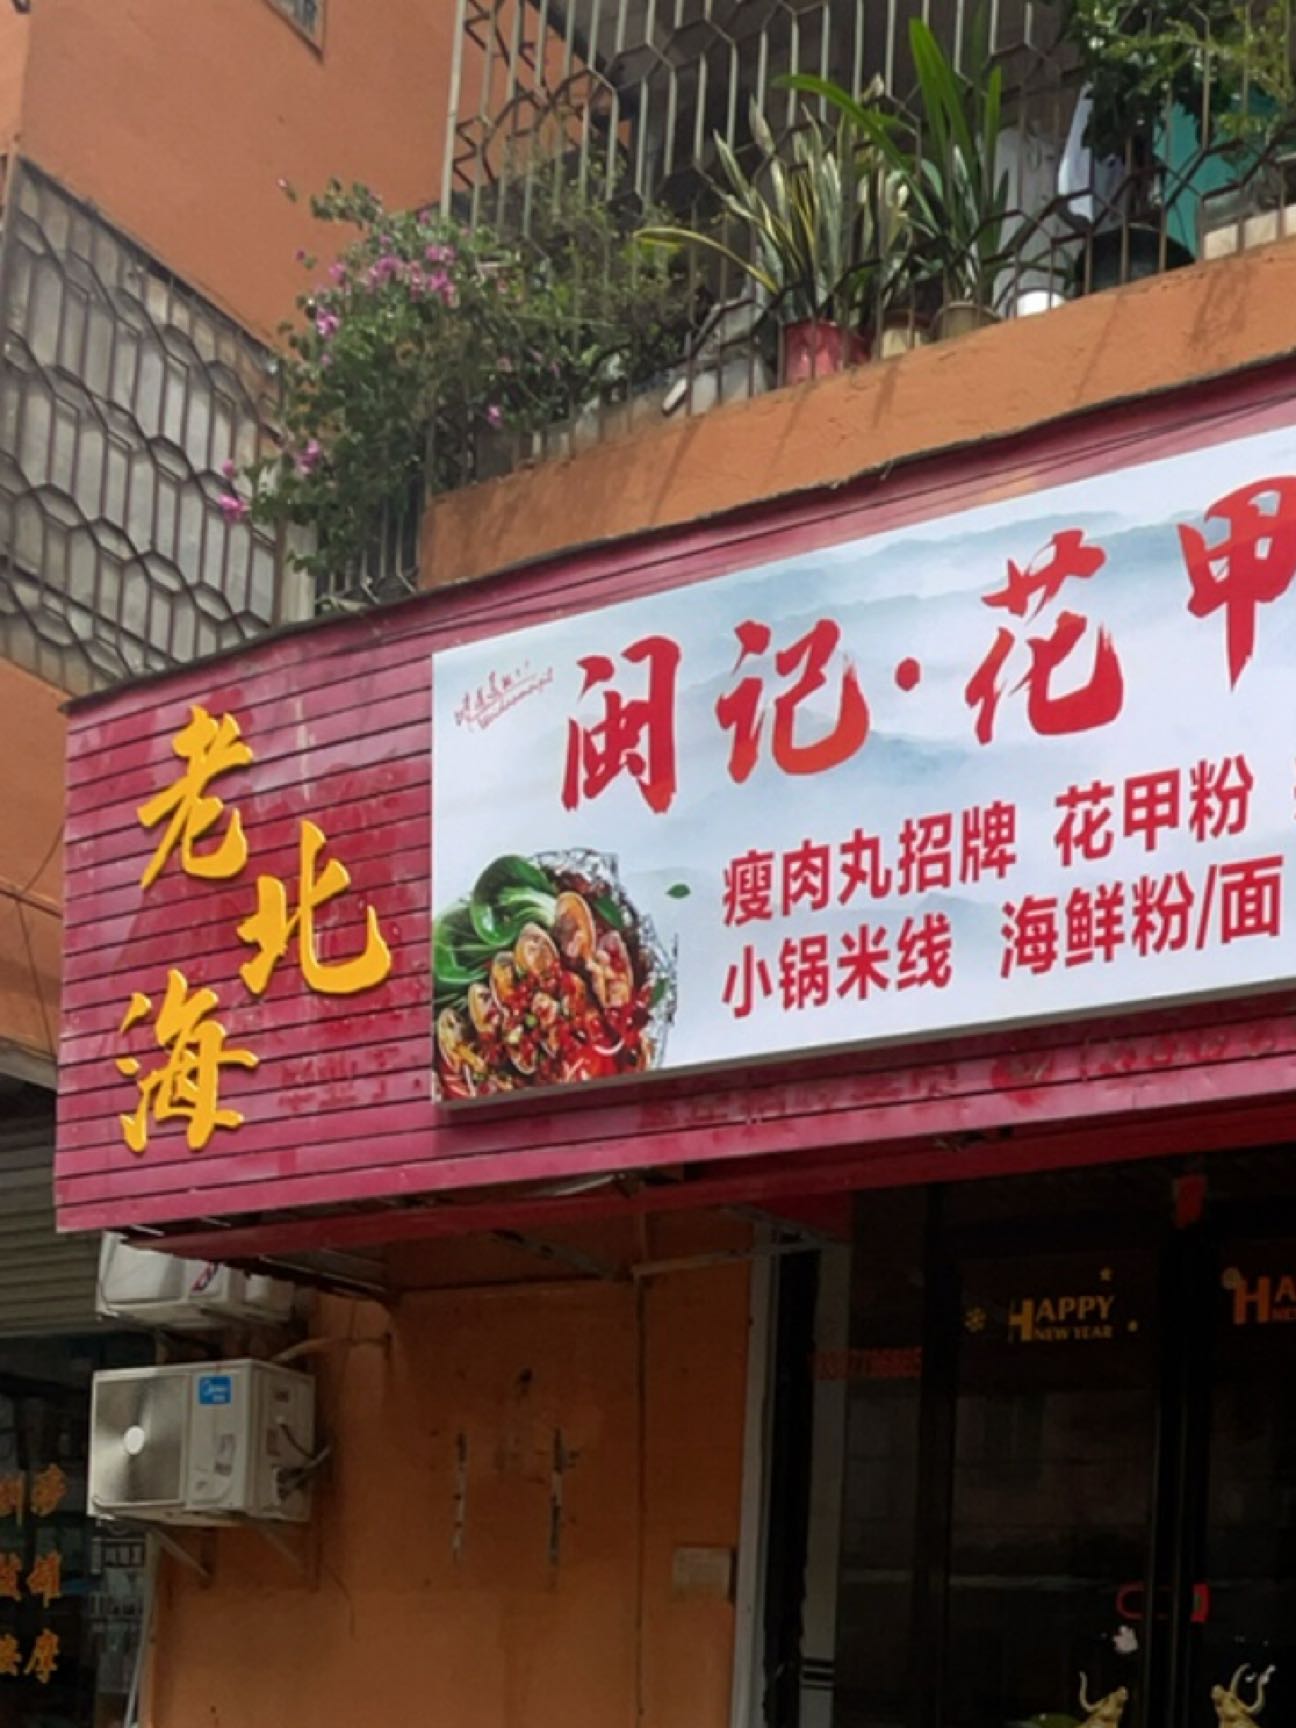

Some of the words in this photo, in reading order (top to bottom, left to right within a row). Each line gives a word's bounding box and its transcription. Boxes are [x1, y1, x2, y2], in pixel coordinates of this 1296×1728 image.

[723, 801, 1017, 928] 瘦肉丸招牌
[1054, 754, 1255, 867] 花甲粉
[116, 703, 393, 1154] 老北海
[721, 914, 953, 1019] 小锅米线
[1000, 854, 1284, 978] 海鲜粉/面
[1008, 1295, 1115, 1343] HAPPY
